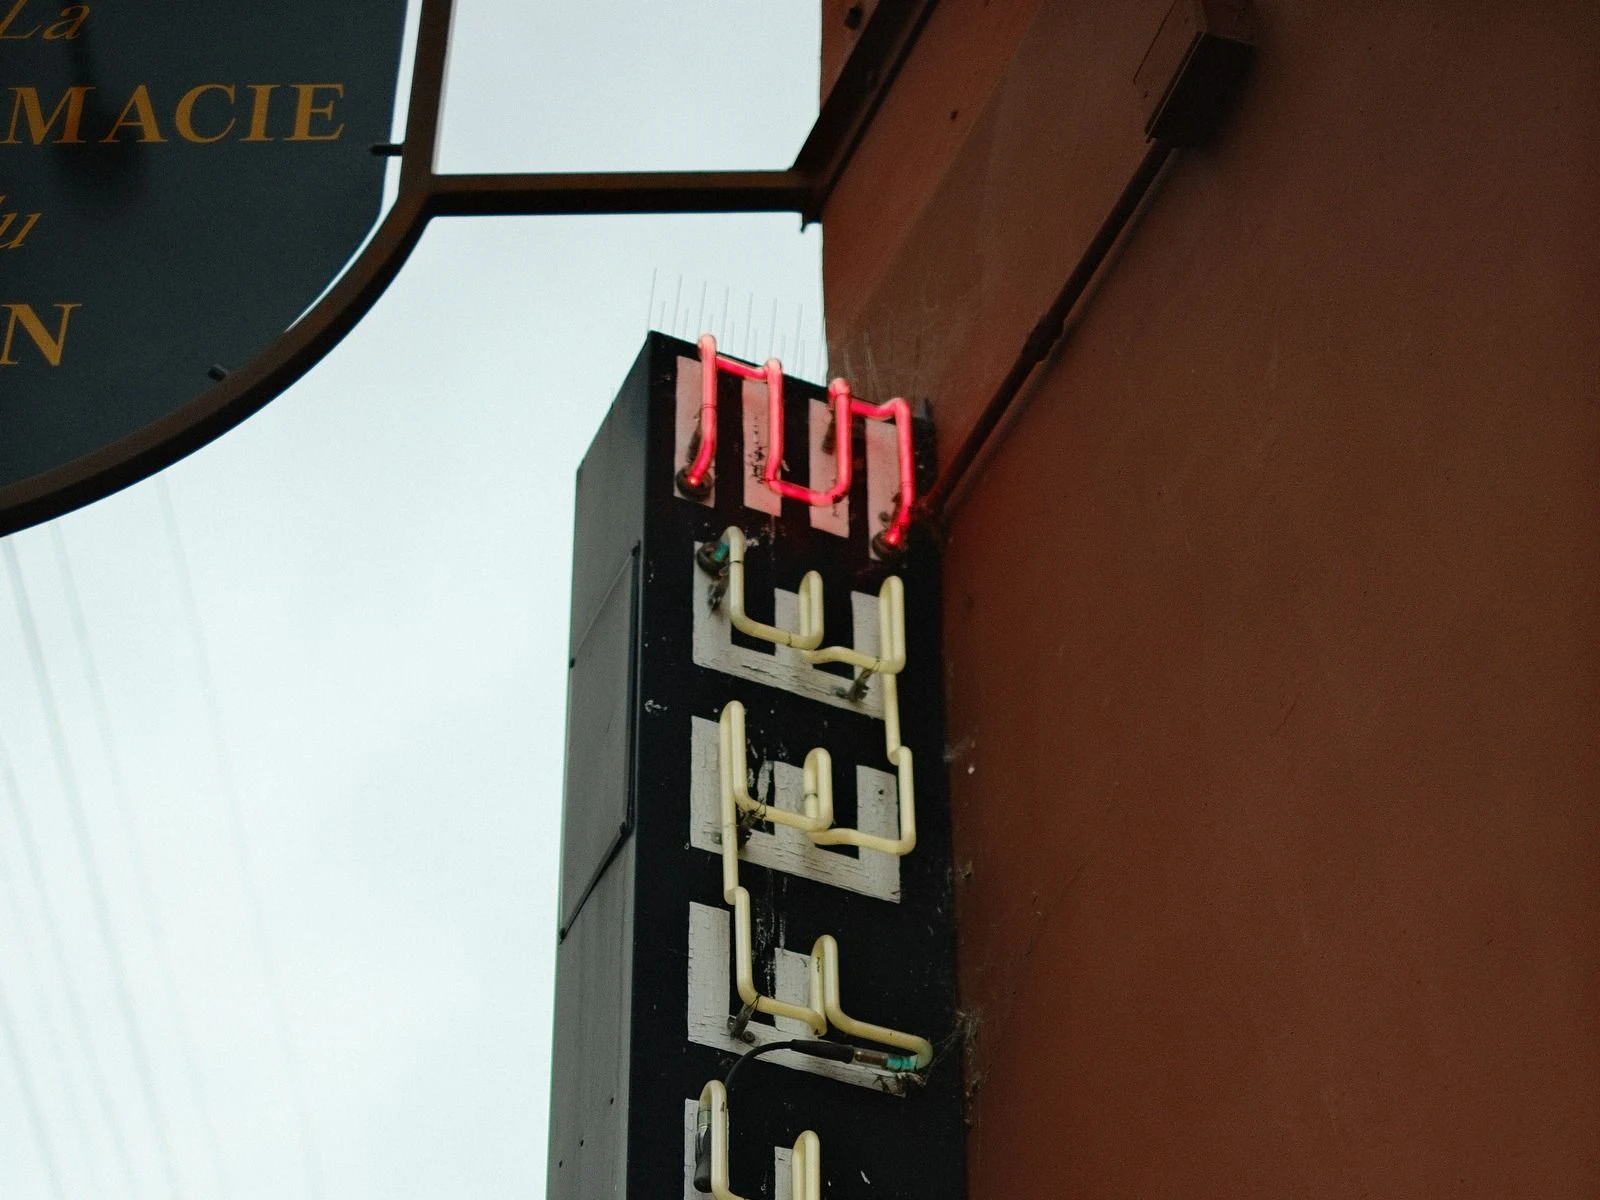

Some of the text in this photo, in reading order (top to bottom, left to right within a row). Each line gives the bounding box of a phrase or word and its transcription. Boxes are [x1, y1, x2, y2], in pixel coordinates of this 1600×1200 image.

[0, 0, 90, 40] La
[0, 83, 346, 144] MACIE
[0, 194, 42, 250] u
